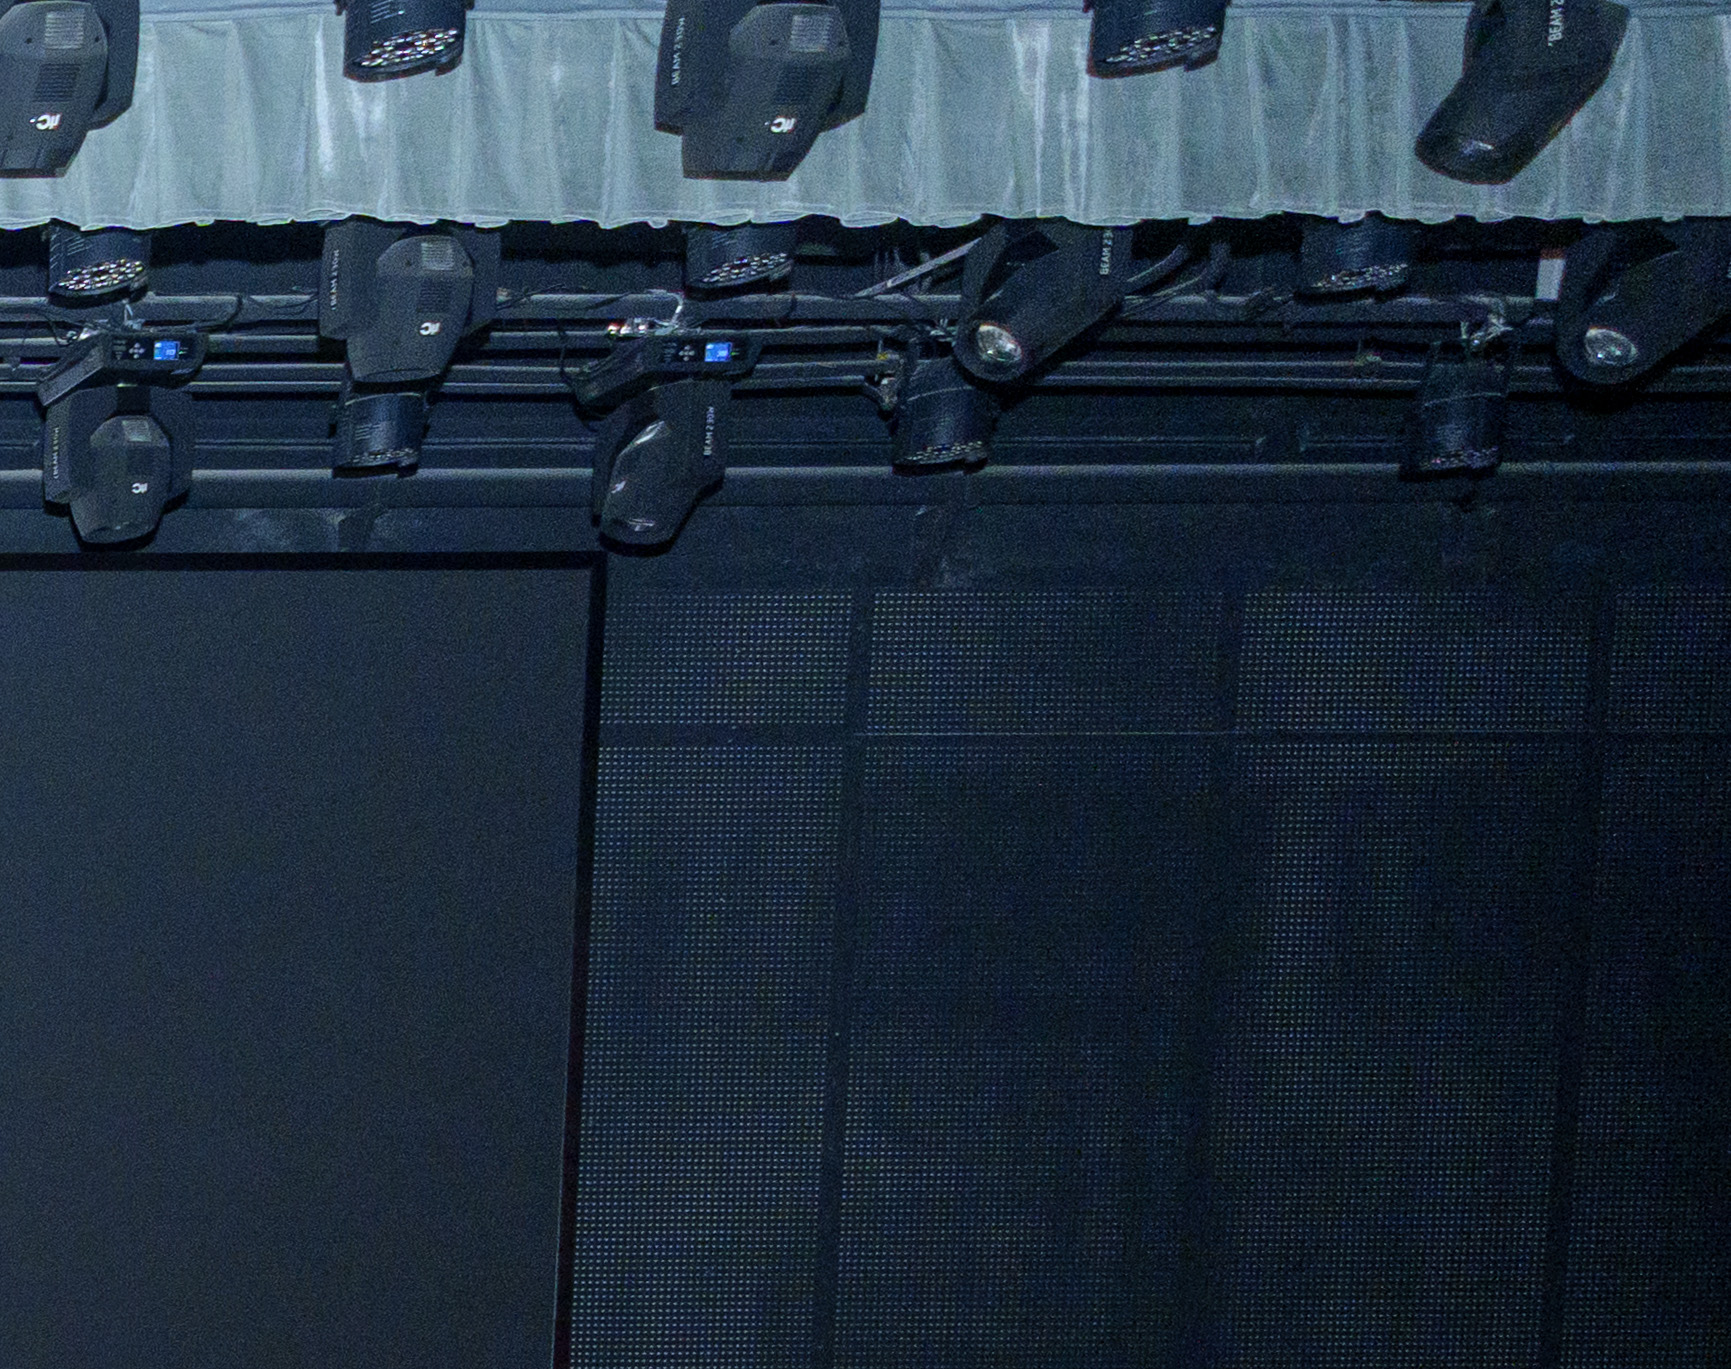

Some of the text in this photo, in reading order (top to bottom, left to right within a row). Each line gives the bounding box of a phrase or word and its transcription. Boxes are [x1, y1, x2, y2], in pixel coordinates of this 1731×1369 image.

[1548, 8, 1564, 41] BEAM
[1099, 247, 1111, 275] BEAM
[703, 406, 714, 456] BEAM 230W
